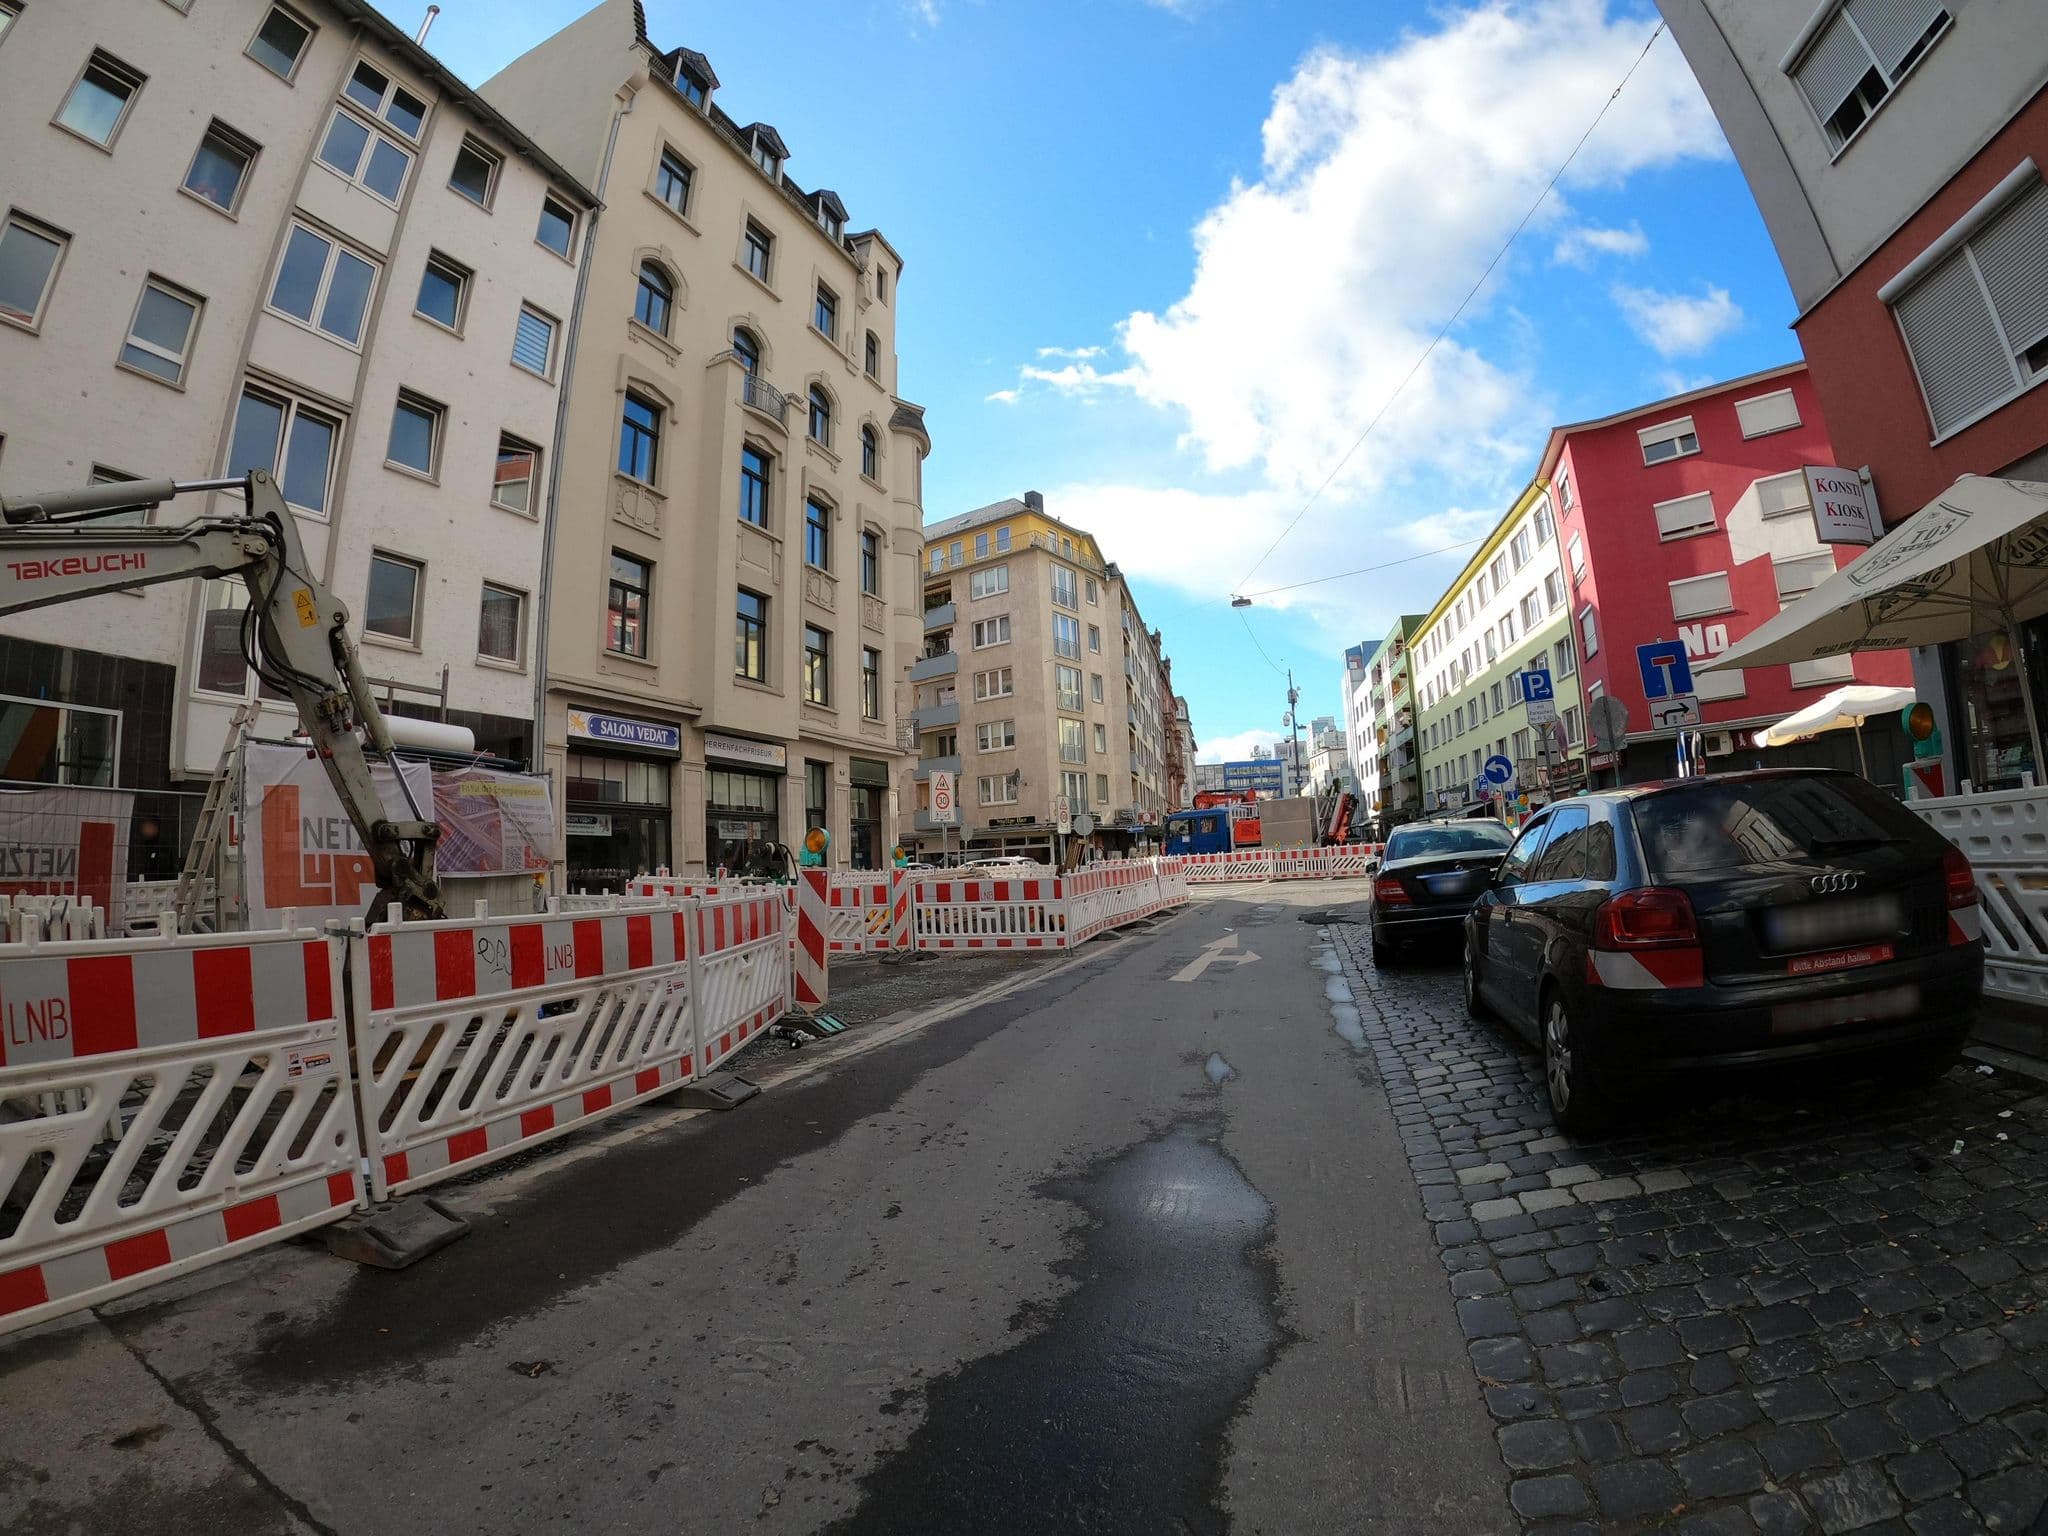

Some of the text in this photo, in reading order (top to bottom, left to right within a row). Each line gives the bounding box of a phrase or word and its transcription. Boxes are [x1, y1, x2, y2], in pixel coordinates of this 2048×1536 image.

[1814, 478, 1862, 498] KONSTI
[1824, 501, 1865, 520] KIOSK
[7, 553, 146, 580] TAKEUCHI
[1527, 674, 1545, 698] P
[600, 719, 669, 744] SALON VEDAT
[546, 942, 574, 972] LNB
[1813, 953, 1846, 969] Abstand
[9, 998, 69, 1046] LNB
